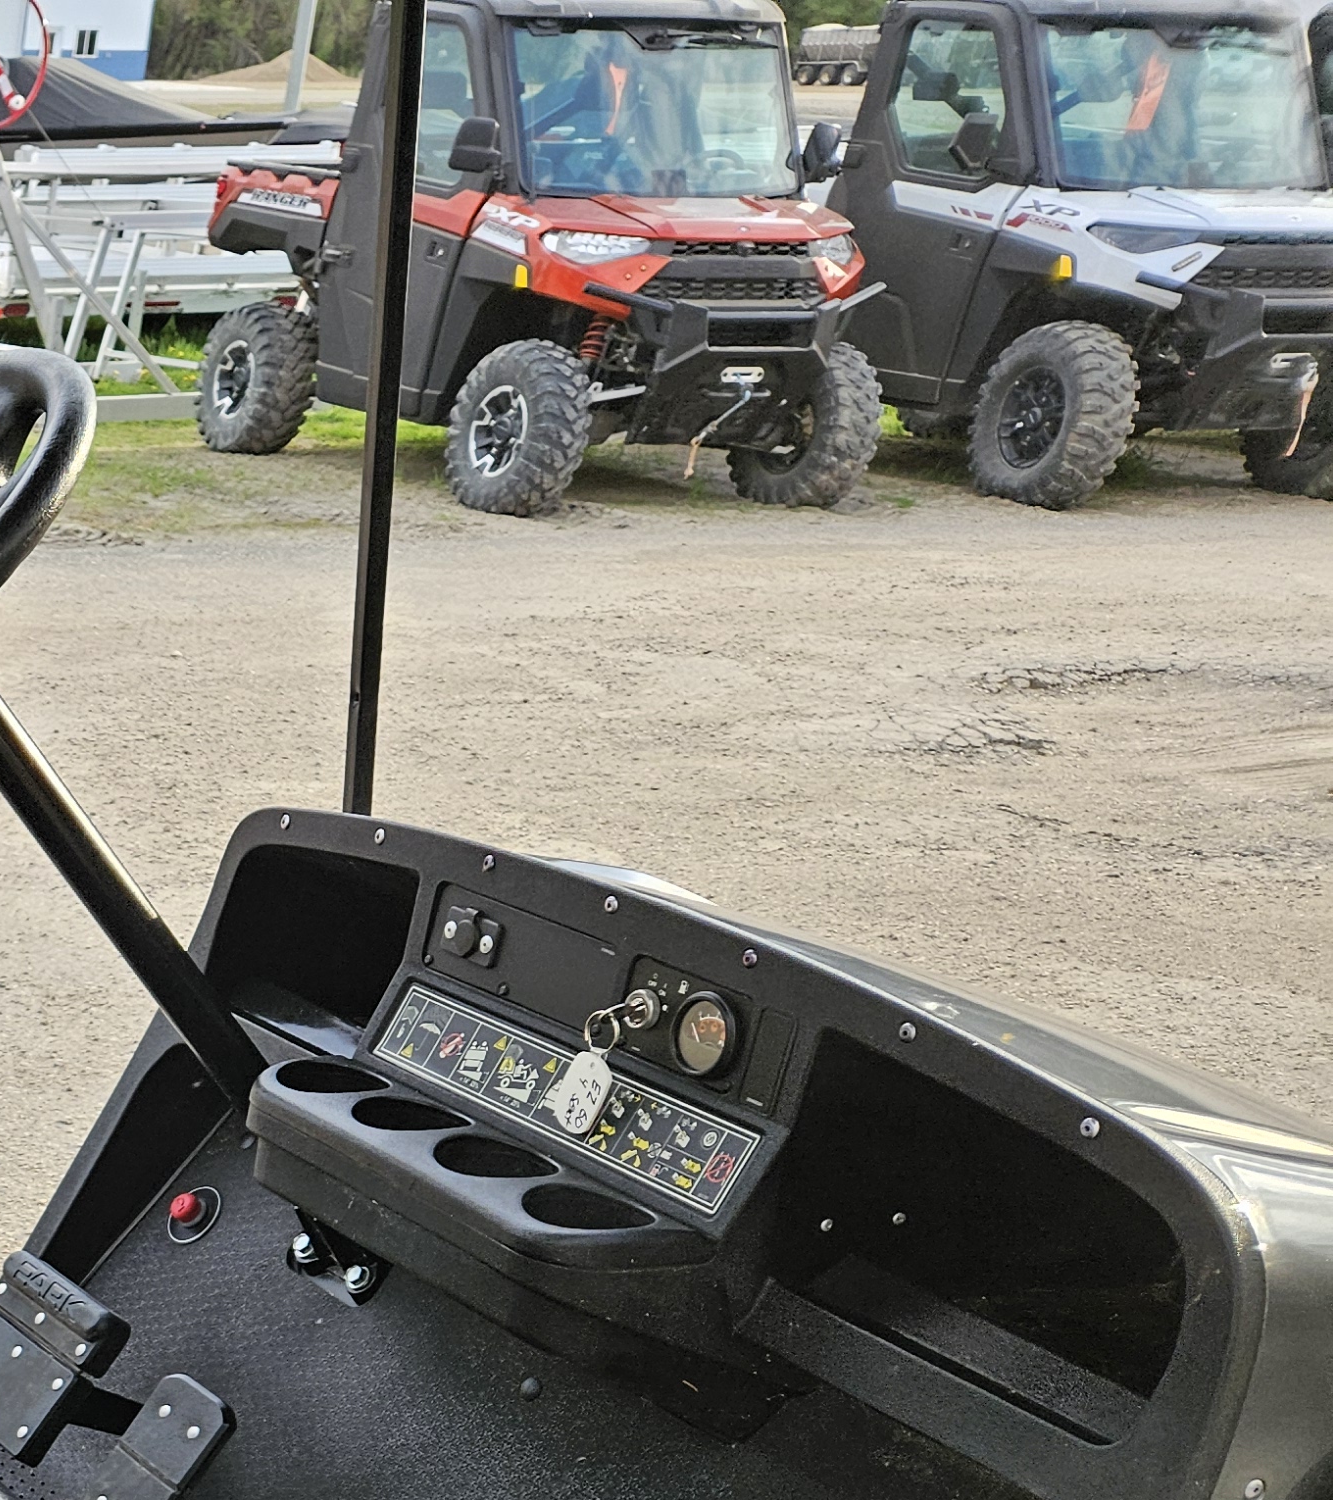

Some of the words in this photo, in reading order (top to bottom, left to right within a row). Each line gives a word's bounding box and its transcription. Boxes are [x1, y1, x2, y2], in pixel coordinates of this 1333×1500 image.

[487, 206, 540, 228] XP
[1017, 199, 1080, 216] XP
[13, 1261, 86, 1323] PARK
